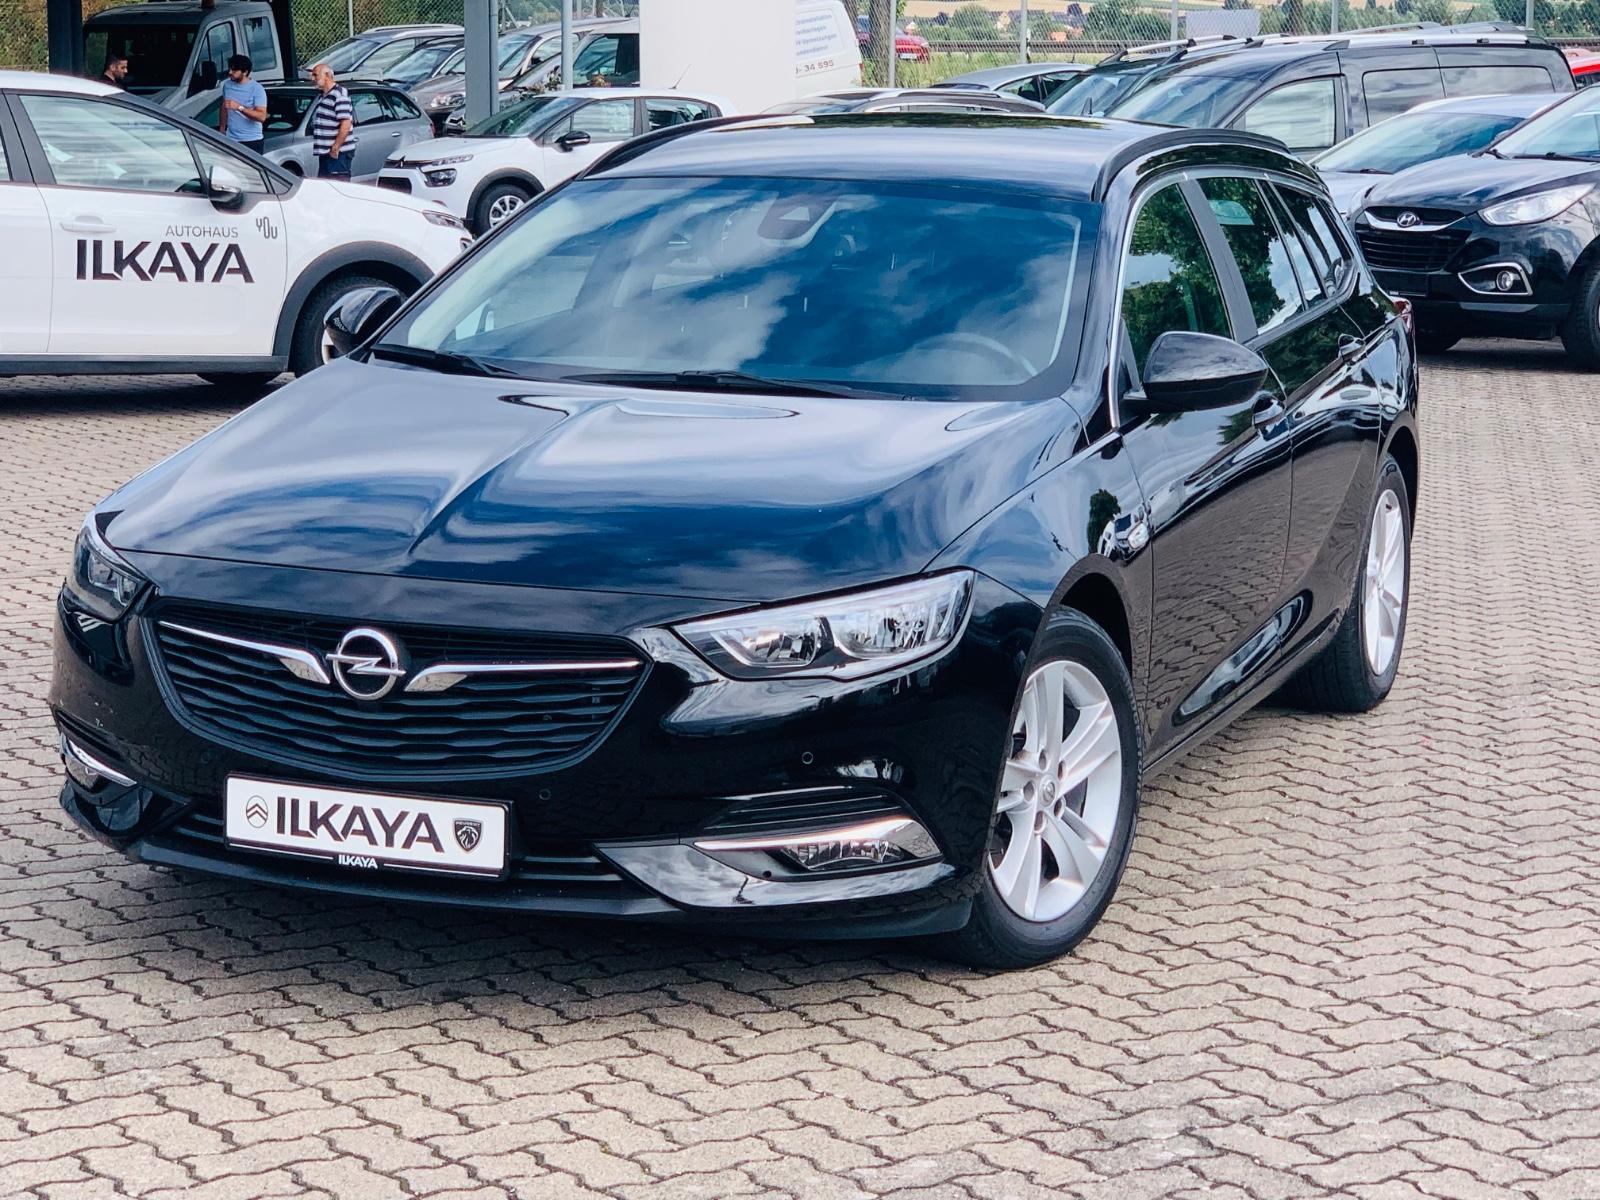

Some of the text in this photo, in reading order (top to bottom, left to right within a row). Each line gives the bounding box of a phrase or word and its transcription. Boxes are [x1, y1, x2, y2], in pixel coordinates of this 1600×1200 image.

[817, 60, 834, 69] 595
[165, 225, 239, 238] AUTOHAUS
[76, 239, 255, 283] ILKAYA
[276, 796, 445, 853] ILKAYA
[337, 854, 378, 869] ILKAYA
